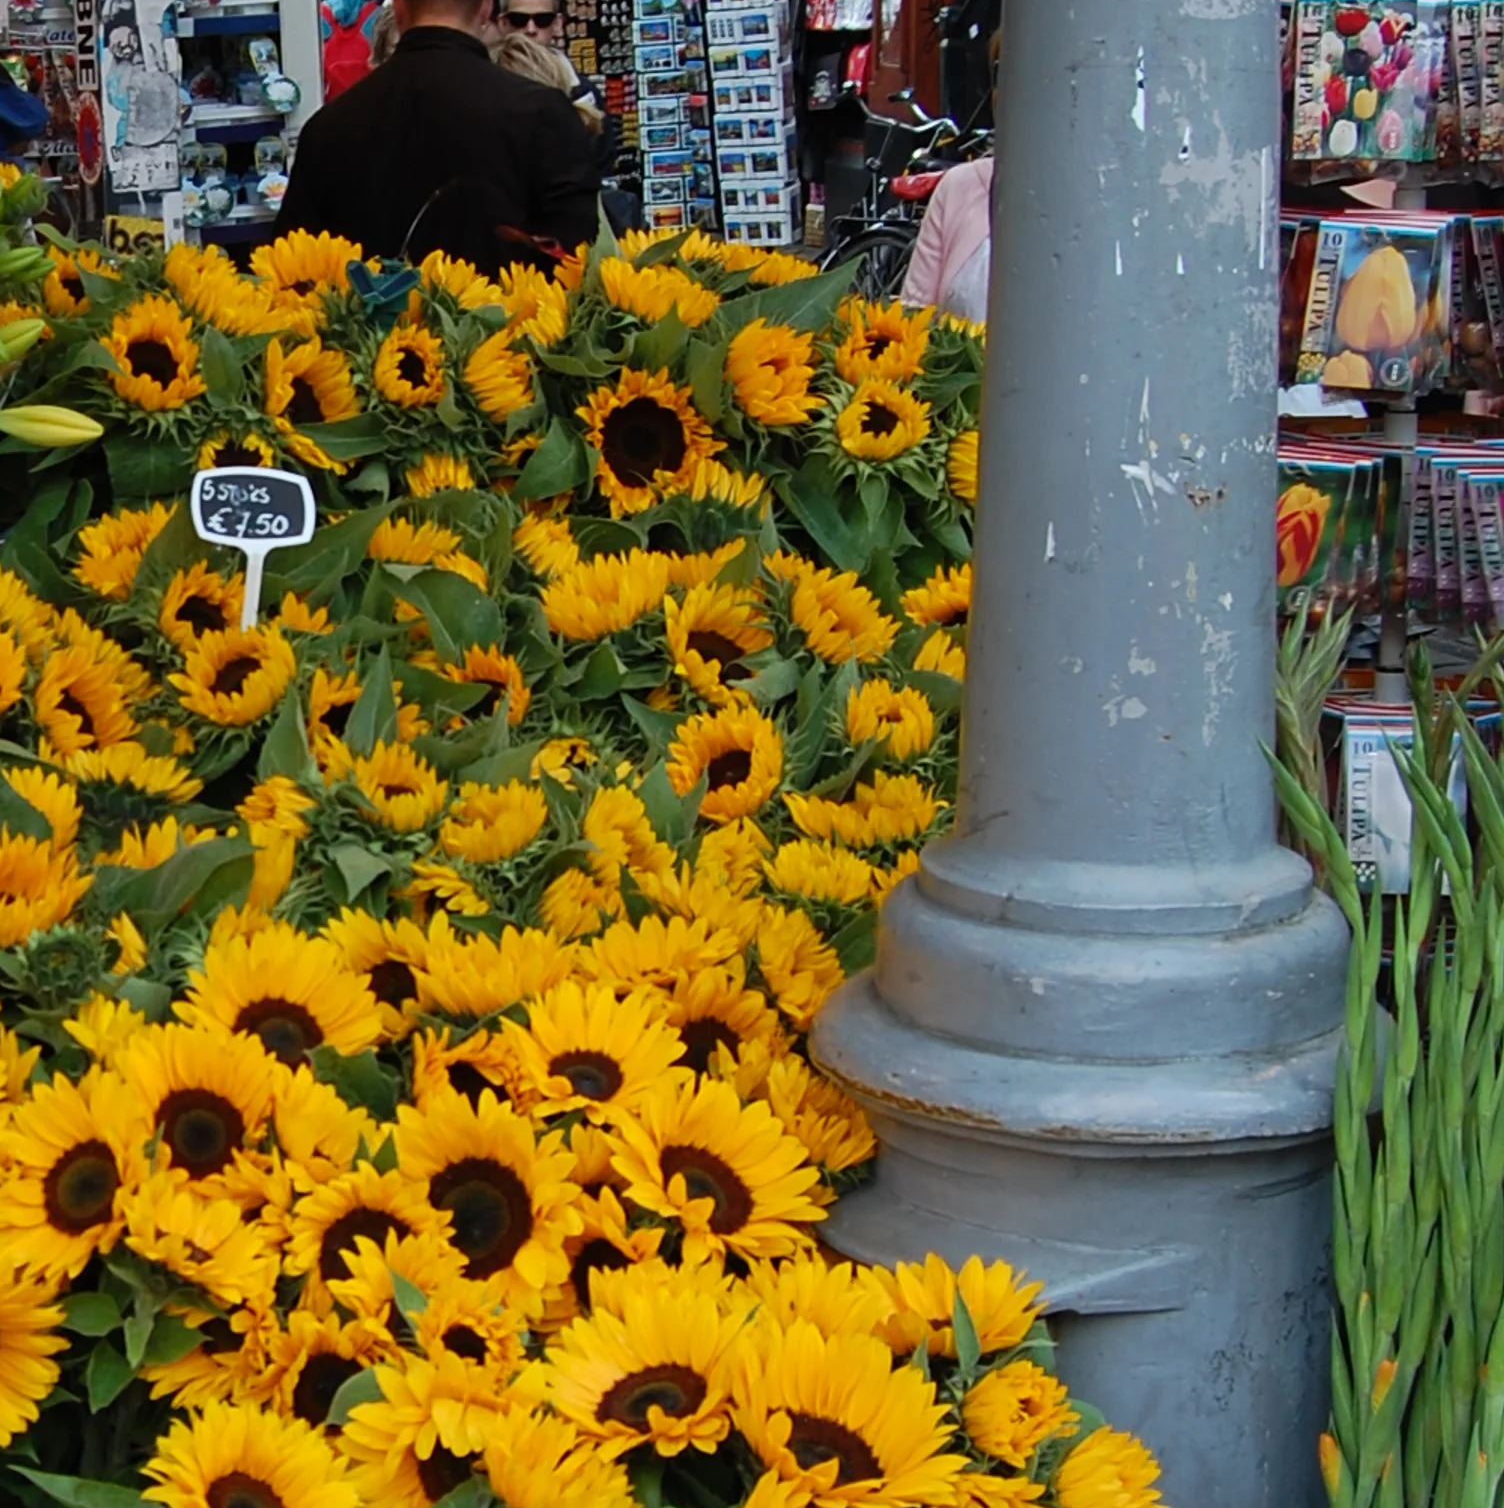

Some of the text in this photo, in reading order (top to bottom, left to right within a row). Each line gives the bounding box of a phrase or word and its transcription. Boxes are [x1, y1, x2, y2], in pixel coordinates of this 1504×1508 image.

[1299, 20, 1323, 107] TULIPA
[1321, 231, 1343, 248] 10
[1308, 249, 1339, 333] TULIPA
[1437, 468, 1456, 483] 10
[1439, 488, 1457, 569] TULIPA
[1352, 741, 1374, 755] 10
[1350, 761, 1372, 842] TULIPA
